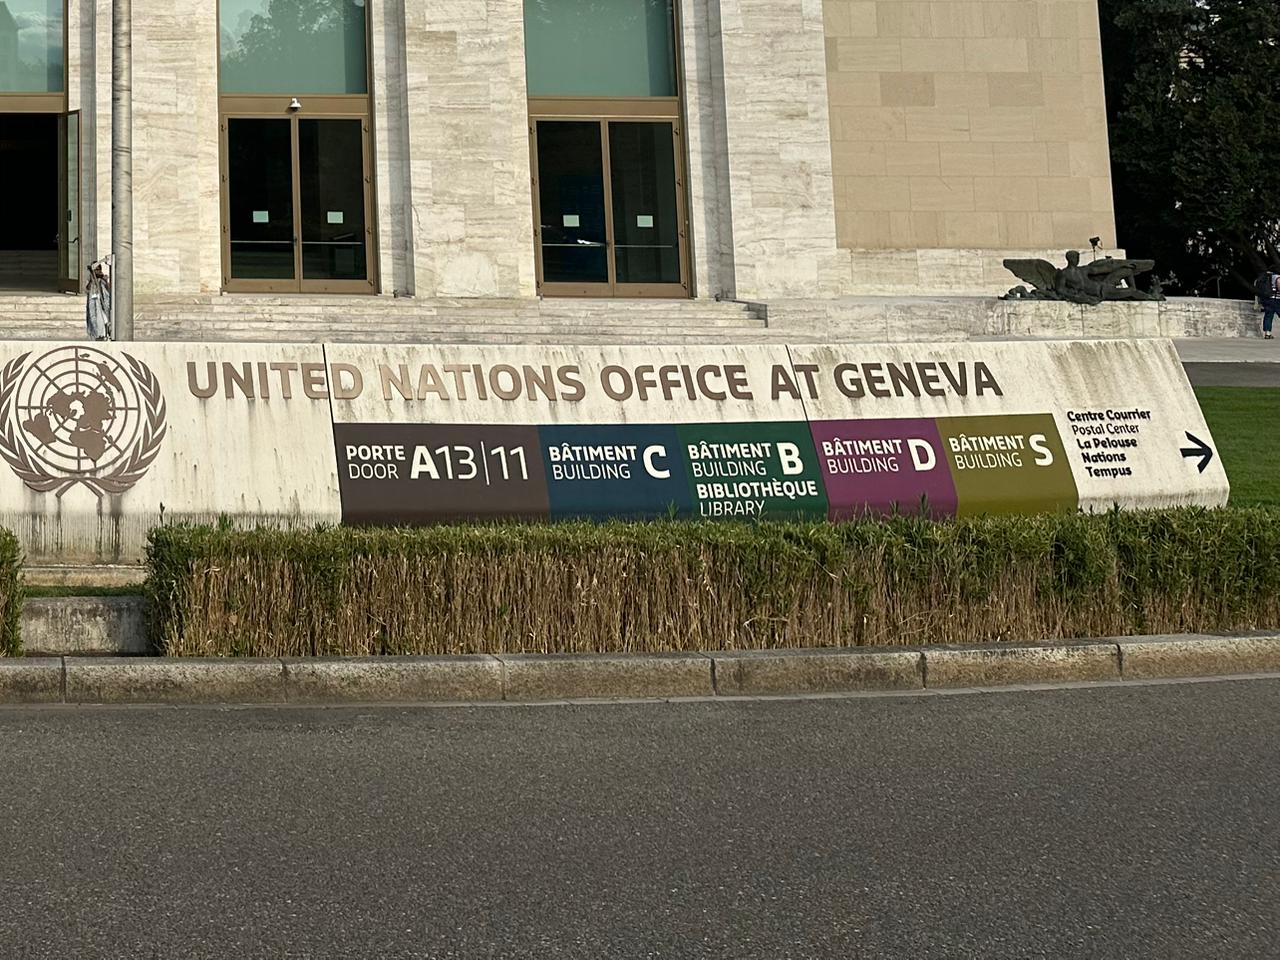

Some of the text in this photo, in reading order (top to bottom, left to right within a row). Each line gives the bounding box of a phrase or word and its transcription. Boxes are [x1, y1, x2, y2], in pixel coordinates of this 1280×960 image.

[187, 360, 1004, 401] UNITED NATIONS OFFICE AT GENEVA
[1067, 409, 1151, 422] Centre Courrier
[1071, 423, 1140, 436] Postal Center
[949, 433, 1054, 466] BÂTIMENT S
[1076, 437, 1138, 450] La Pelouse
[345, 445, 406, 461] PORTE
[549, 443, 671, 480] BÂTIMENT C
[687, 441, 804, 475] BÂTIMENT B
[822, 437, 938, 472] BÂTIMENT D
[955, 452, 1023, 470] BUILDING
[1081, 451, 1127, 464] Nations
[348, 464, 399, 479] DOOR
[552, 462, 631, 481] BUILDING
[692, 461, 767, 478] BUILDING
[827, 457, 899, 474] BUILDING
[1085, 466, 1132, 479] Tempus
[696, 478, 818, 500] BIBLIOTHÈQUE
[700, 500, 765, 517] LIBRARY
